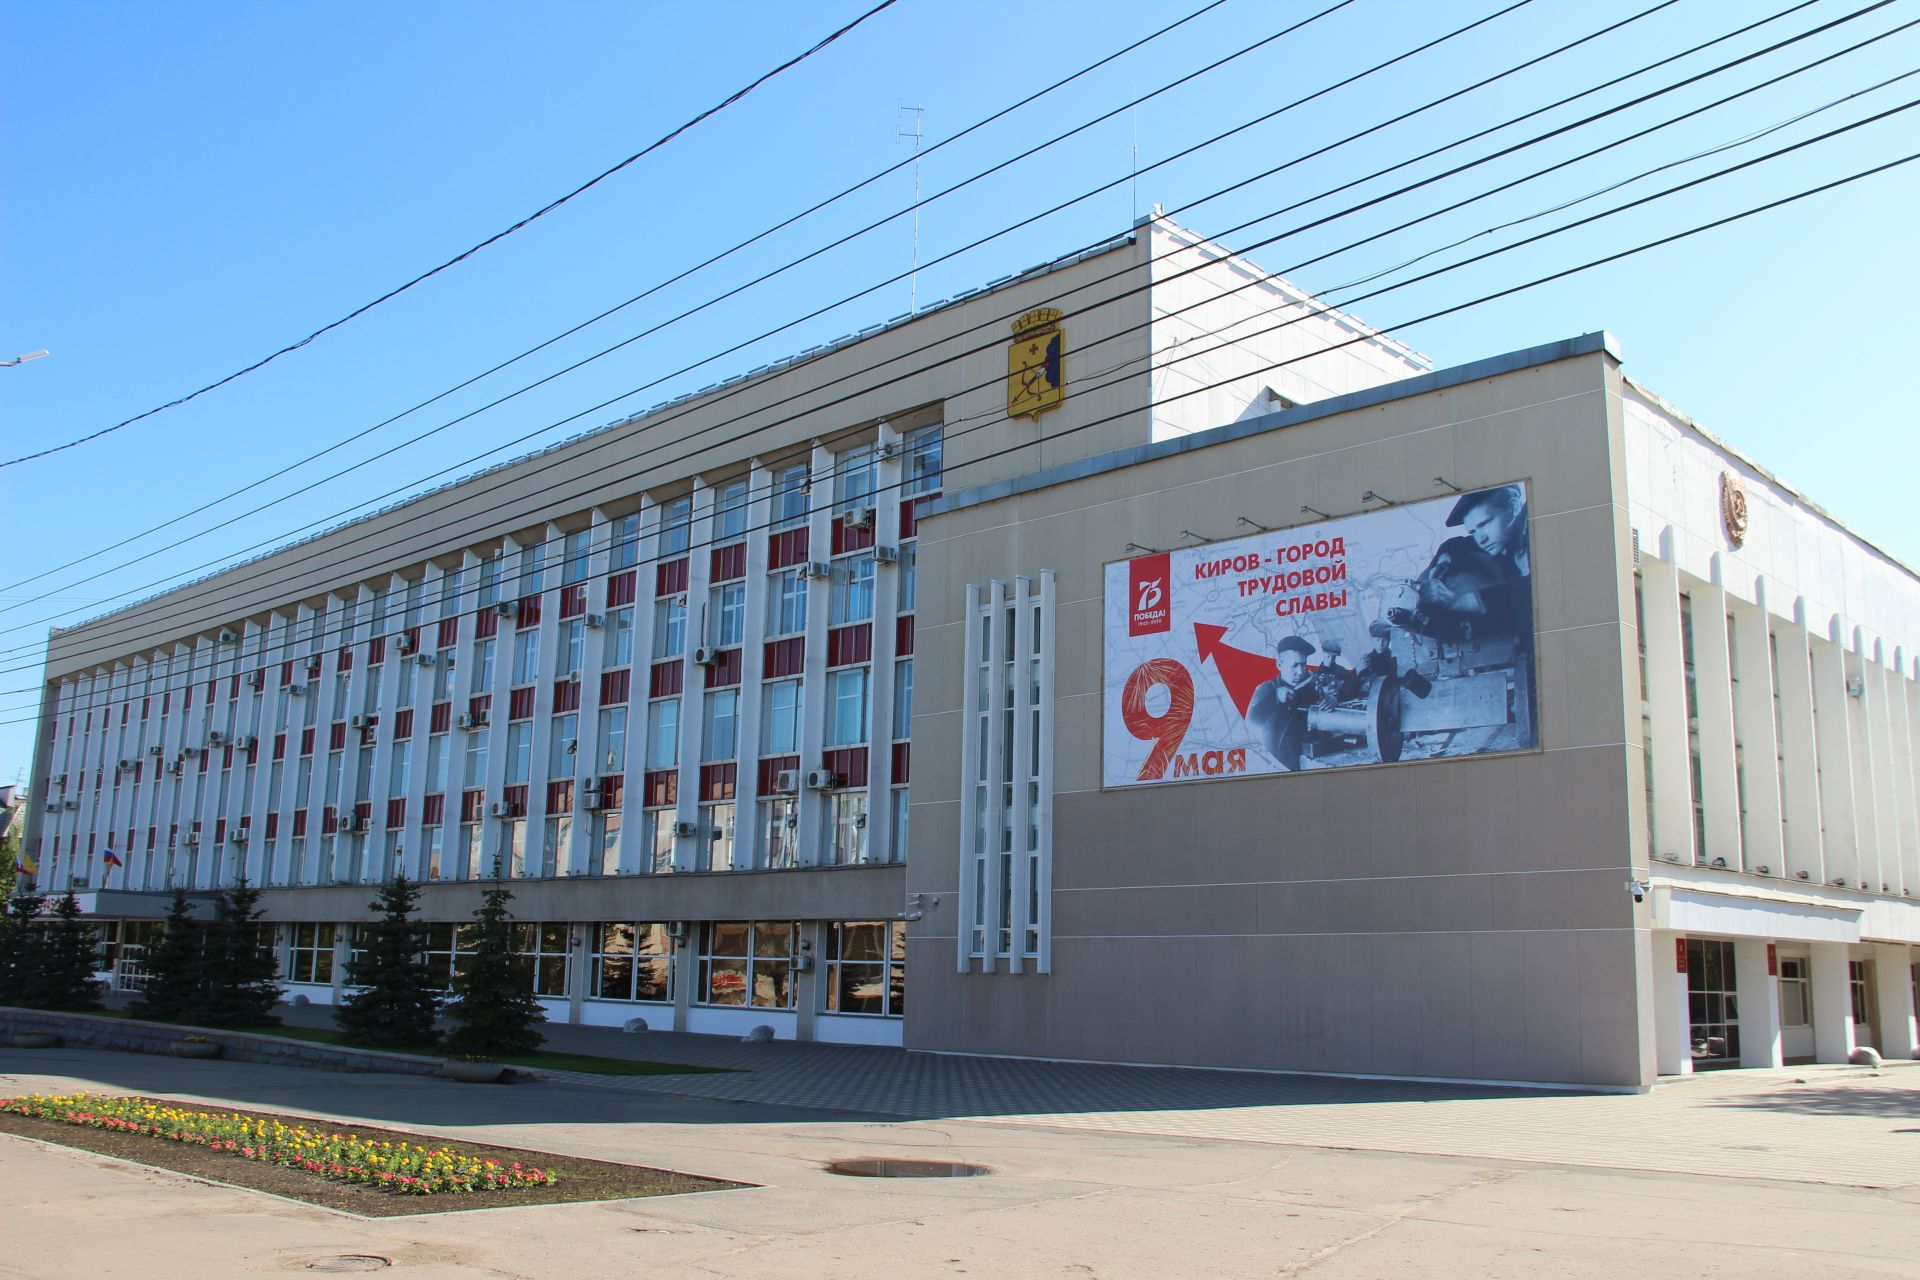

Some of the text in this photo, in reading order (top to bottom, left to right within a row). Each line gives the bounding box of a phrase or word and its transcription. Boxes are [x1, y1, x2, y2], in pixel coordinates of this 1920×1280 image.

[1195, 553, 1260, 579] КИРОВ
[1277, 537, 1345, 564] ГОРОД
[1139, 577, 1162, 611] 75
[1237, 559, 1346, 597] ТРУДОВОЙ
[1134, 609, 1166, 621] ПОБЕДА!
[1275, 589, 1347, 617] СЛАВЫ
[1121, 657, 1195, 781] 9
